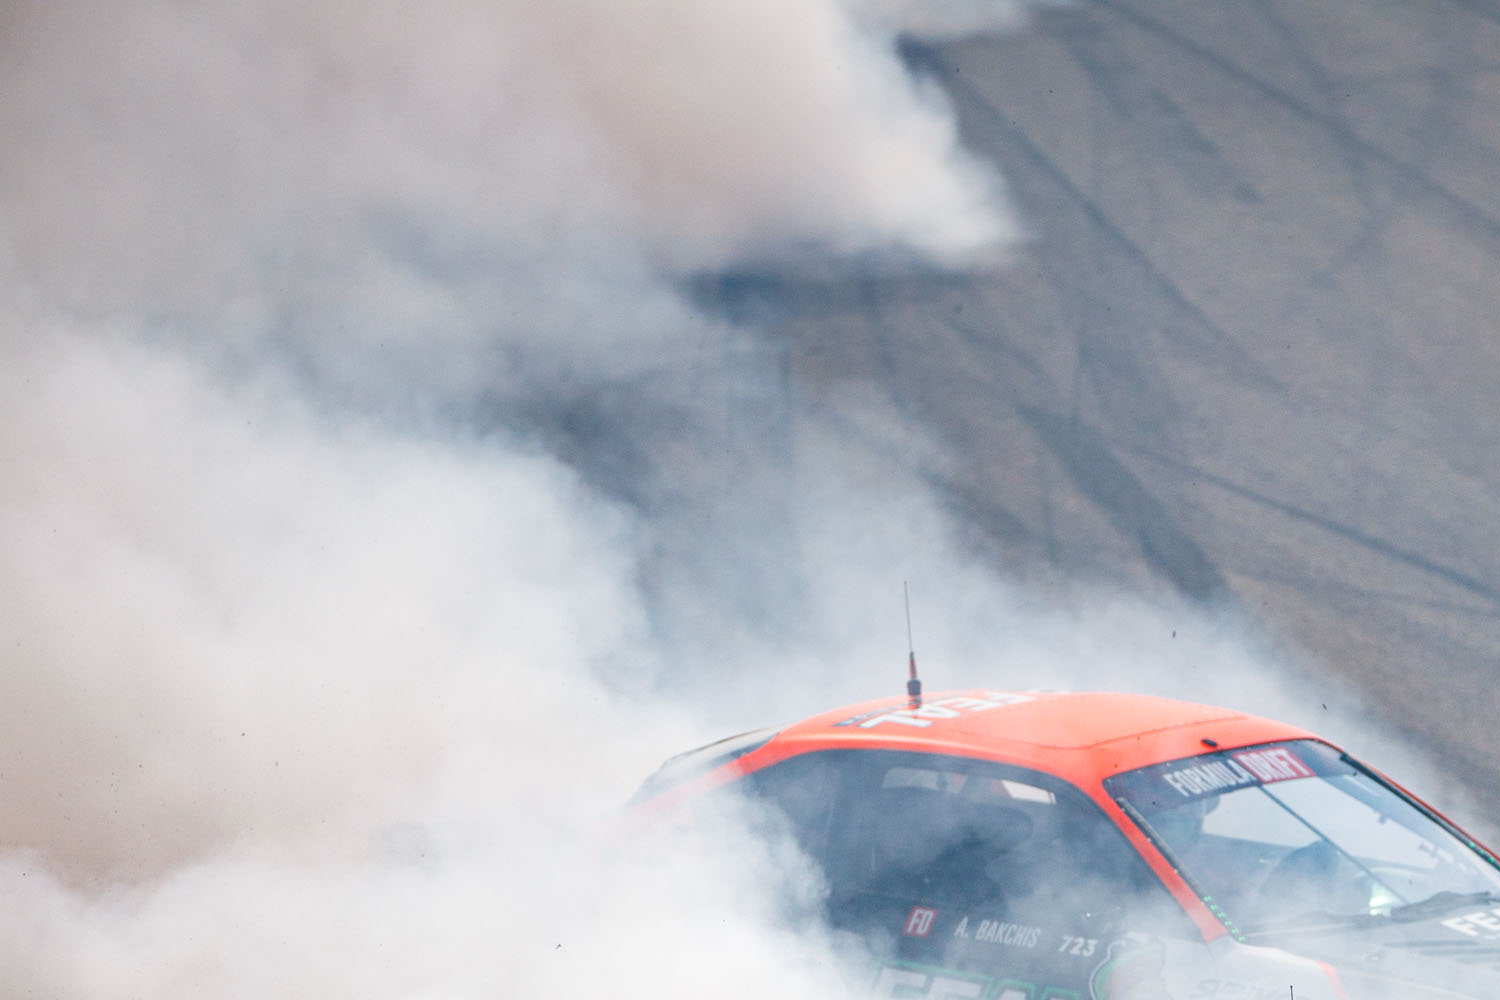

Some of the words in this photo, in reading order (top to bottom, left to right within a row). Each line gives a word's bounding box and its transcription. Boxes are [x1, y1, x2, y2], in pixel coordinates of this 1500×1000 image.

[1163, 759, 1257, 797] FORMULA
[1237, 749, 1311, 782] DRIFT
[907, 909, 933, 934] FD
[954, 916, 968, 938] A.
[976, 920, 1041, 947] BAKCHIS
[1059, 936, 1098, 957] 723
